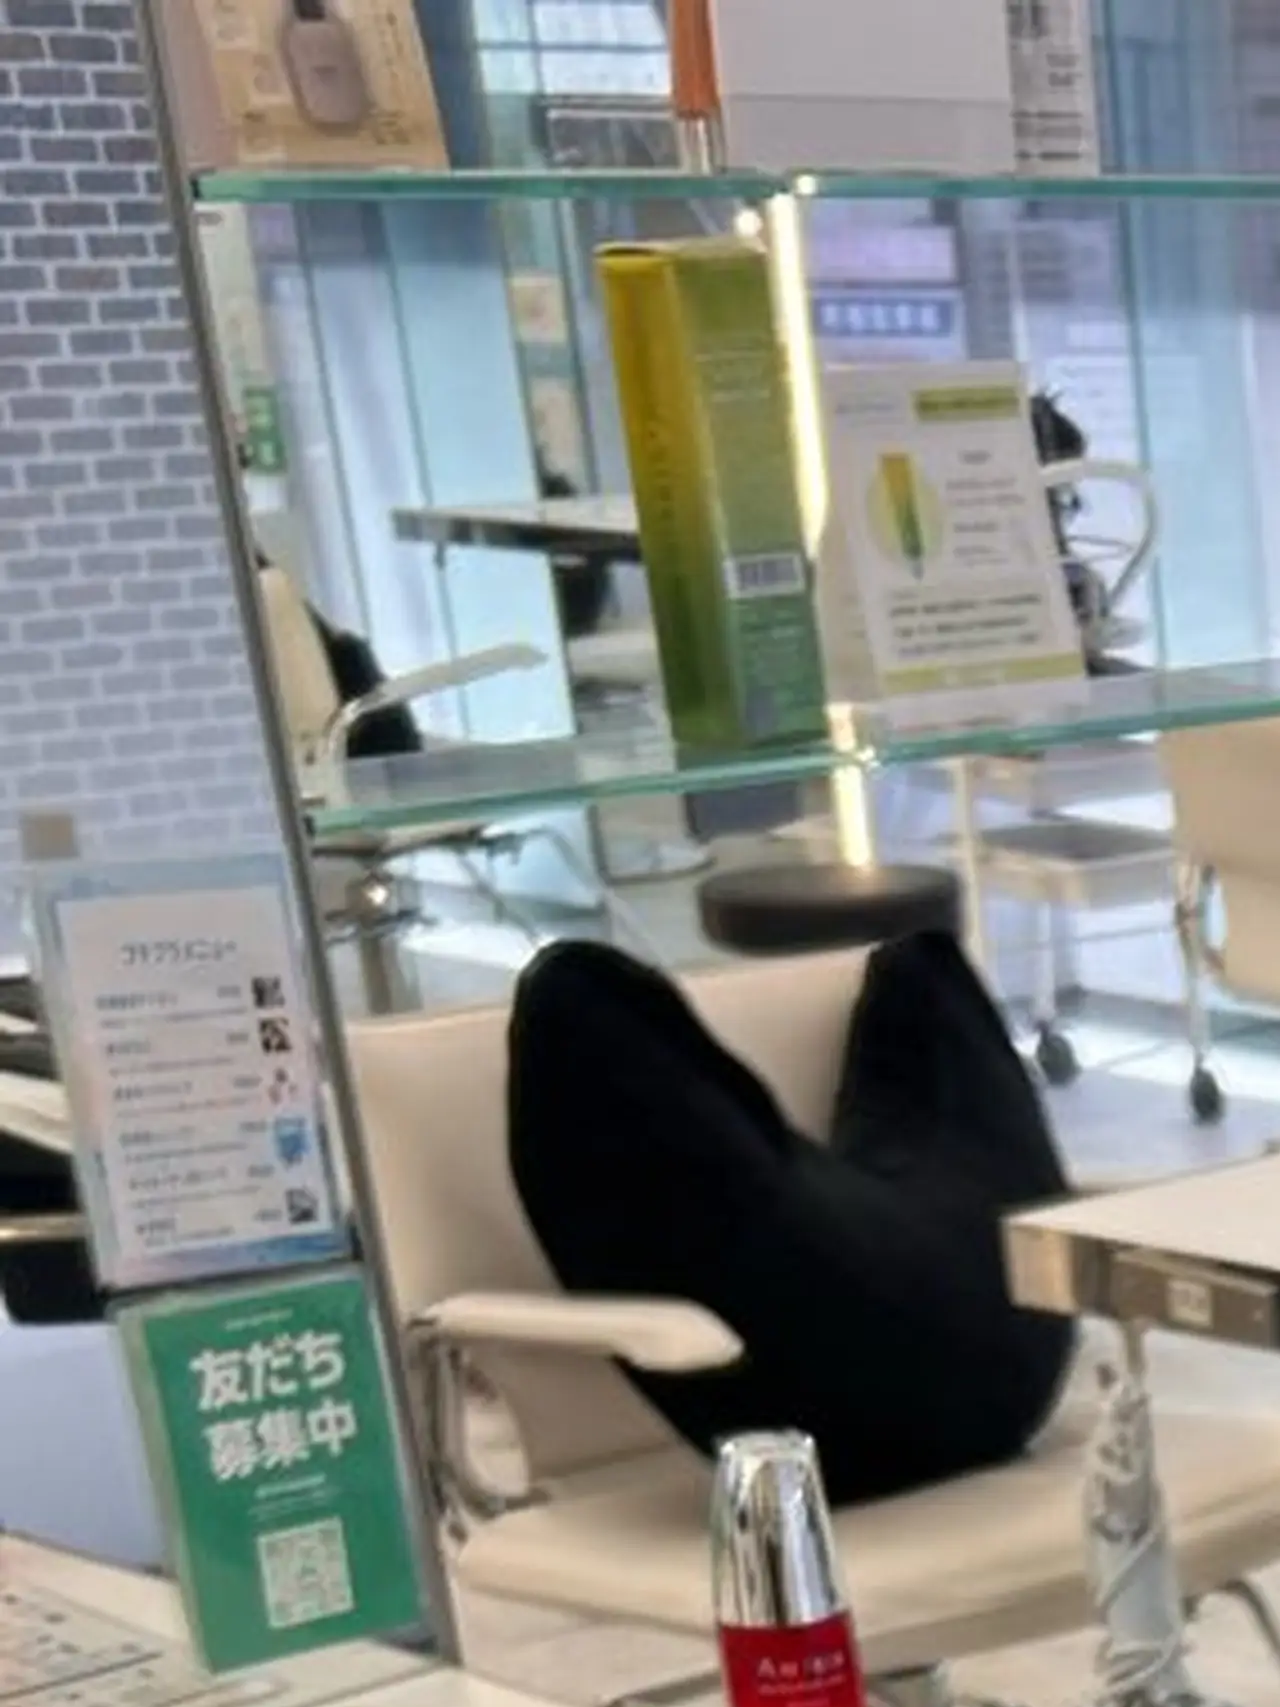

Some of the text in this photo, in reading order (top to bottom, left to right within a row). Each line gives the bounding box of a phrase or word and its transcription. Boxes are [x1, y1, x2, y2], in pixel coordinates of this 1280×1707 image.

[188, 1328, 346, 1413] 友だち
[203, 1396, 358, 1484] 募集中
